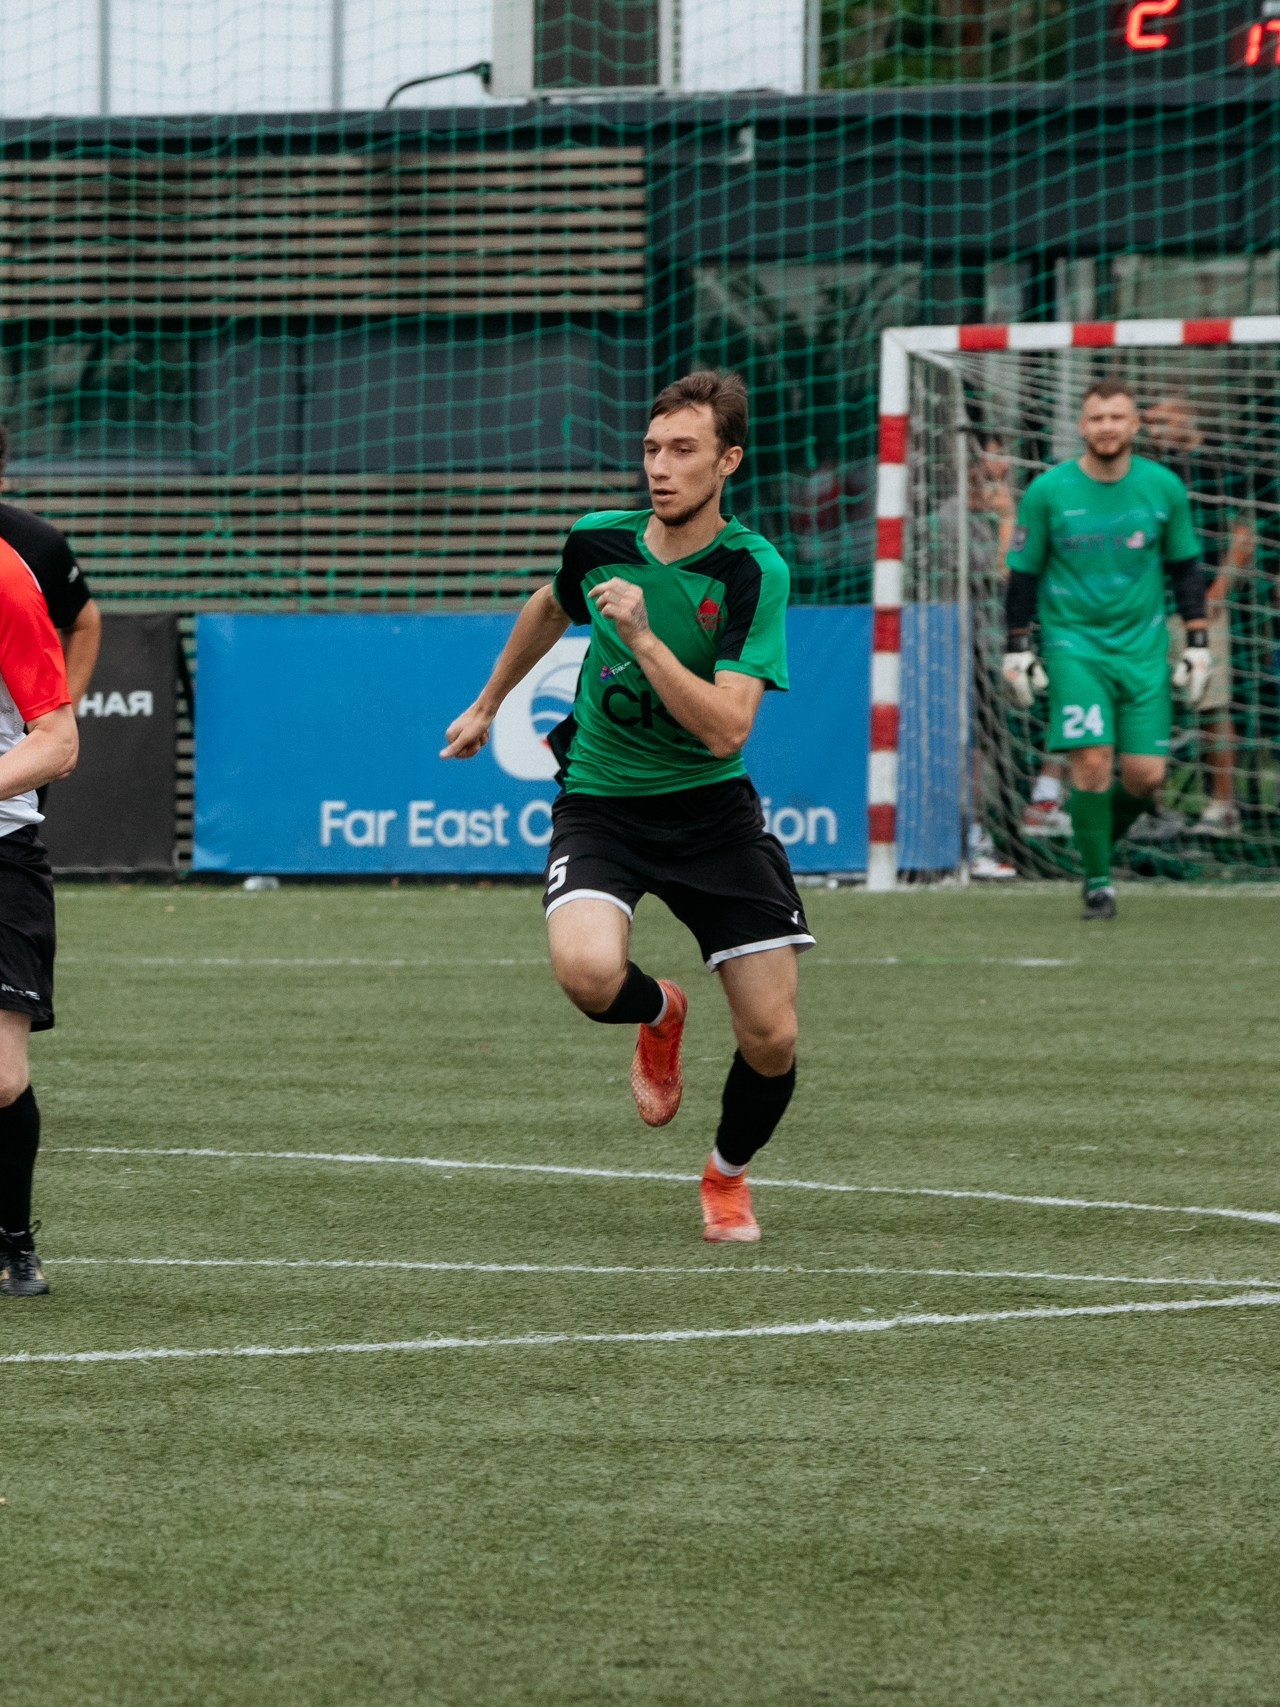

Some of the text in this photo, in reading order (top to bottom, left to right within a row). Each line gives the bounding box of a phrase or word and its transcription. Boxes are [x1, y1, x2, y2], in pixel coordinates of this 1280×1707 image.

[1062, 704, 1104, 738] 24
[321, 800, 398, 847] Far
[408, 800, 510, 847] East
[547, 855, 570, 896] 5
